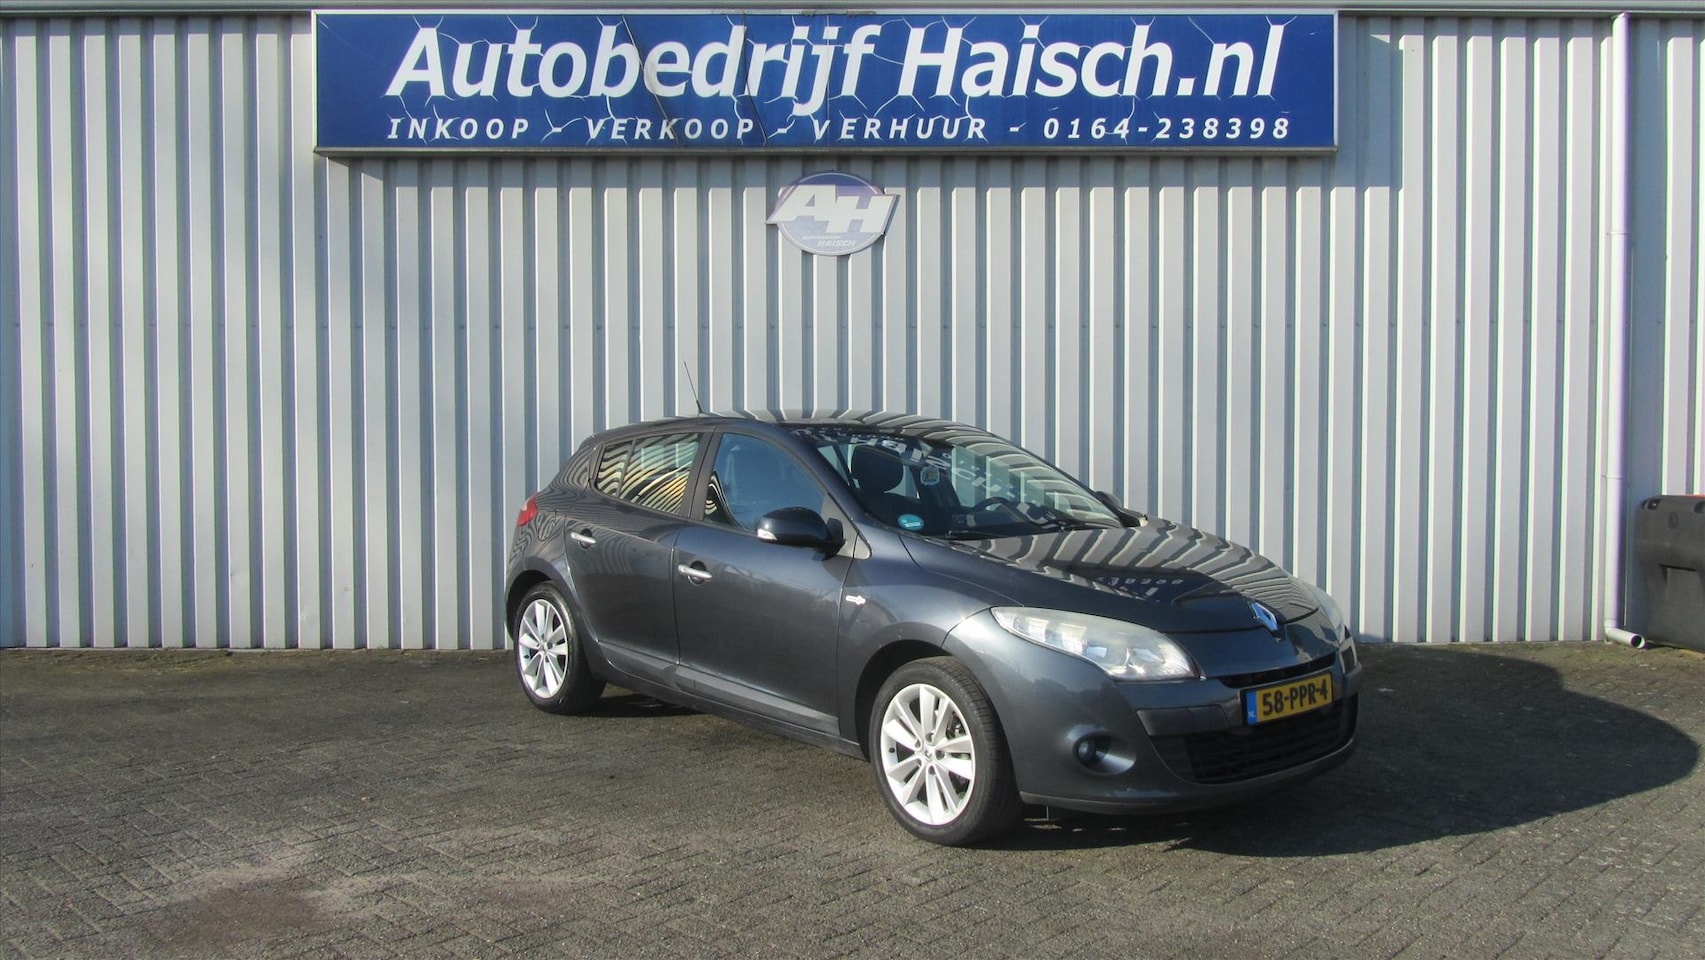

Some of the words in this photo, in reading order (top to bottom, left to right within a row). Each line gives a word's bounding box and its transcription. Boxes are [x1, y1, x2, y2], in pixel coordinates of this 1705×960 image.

[384, 25, 882, 117] Autobedrijf
[899, 24, 1284, 97] Haisch.nl
[387, 118, 530, 140] INKOOP
[587, 118, 754, 140] VERKOOP
[811, 117, 987, 140] VERHUUR
[1042, 117, 1289, 140] 0164-238398
[767, 184, 895, 233] AH
[816, 239, 857, 248] HAISCH
[1262, 678, 1329, 716] 58-PPR-4
